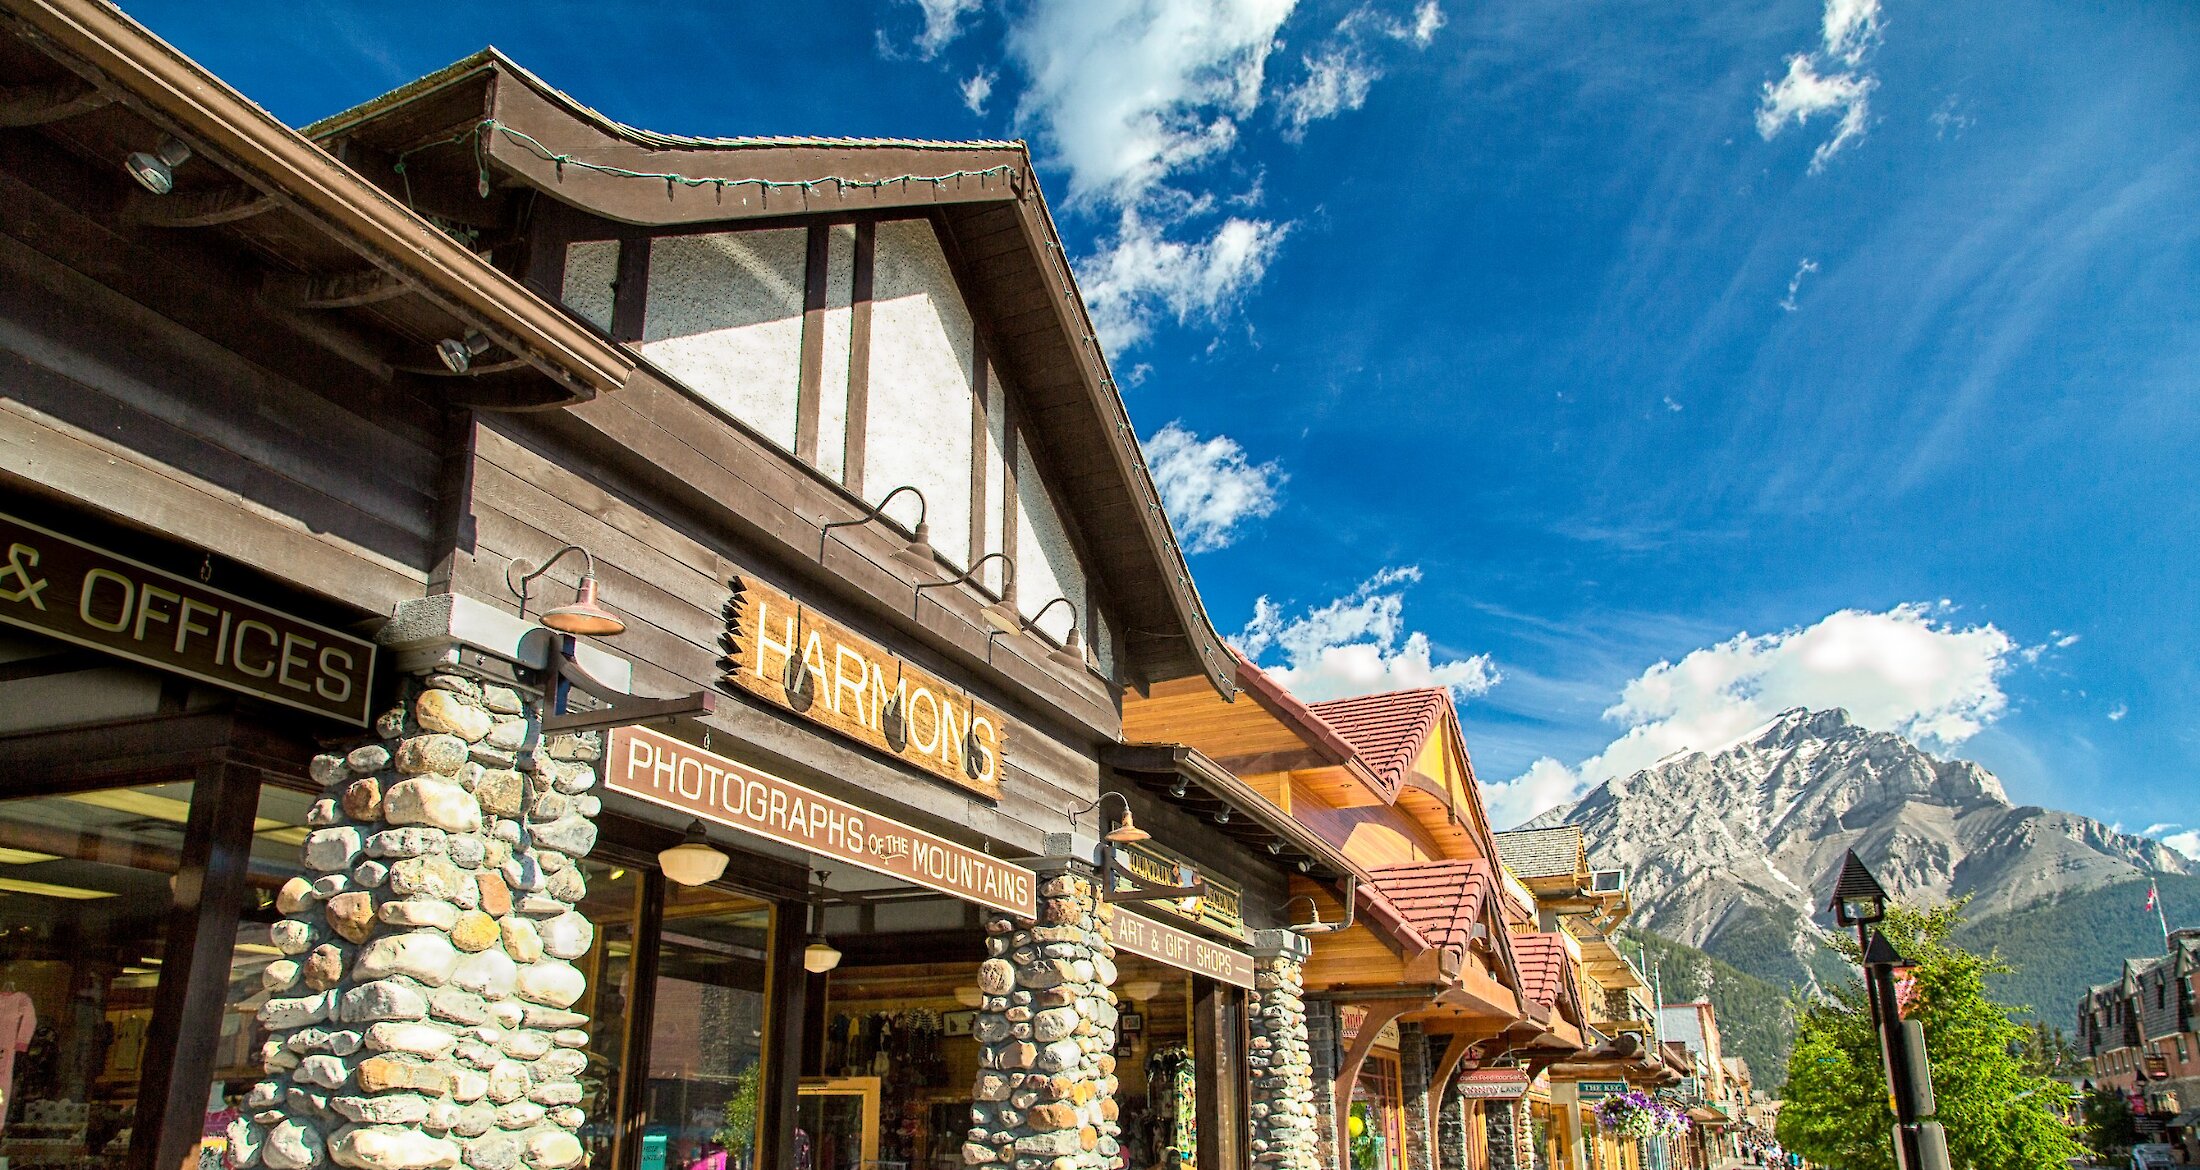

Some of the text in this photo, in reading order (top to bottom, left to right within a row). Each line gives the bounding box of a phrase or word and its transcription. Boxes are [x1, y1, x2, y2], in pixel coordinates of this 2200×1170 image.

[0, 543, 353, 702] & OFFICES
[756, 602, 996, 782] HARMONS
[628, 737, 1028, 906] PHOTOGRAPHS OF THE MOUNTAINS
[1119, 916, 1232, 976] ART & GIFT SHOPS
[1584, 1084, 1622, 1092] THE KEG
